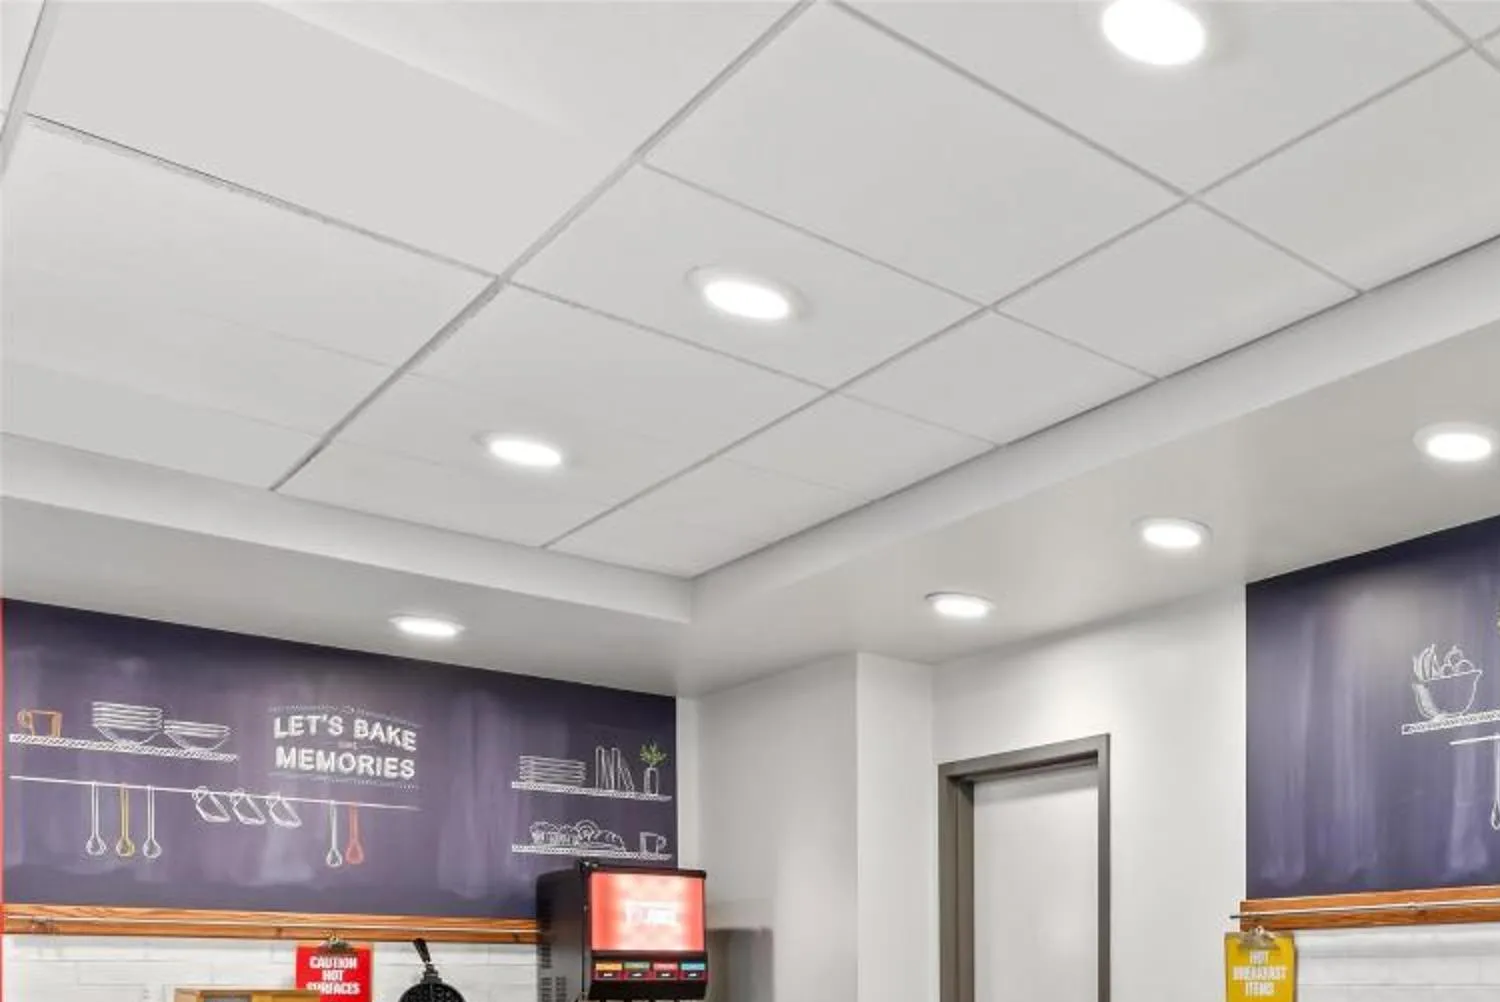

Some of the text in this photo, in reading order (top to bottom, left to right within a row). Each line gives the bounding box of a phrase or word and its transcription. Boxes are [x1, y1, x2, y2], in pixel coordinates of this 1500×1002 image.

[273, 714, 417, 752] LET'S BAKE
[275, 746, 416, 780] MEMORIES
[309, 955, 359, 969] CAUTION
[322, 970, 344, 981] HOT
[1232, 966, 1288, 981] BREAKFAST
[1245, 982, 1276, 996] ITEMS
